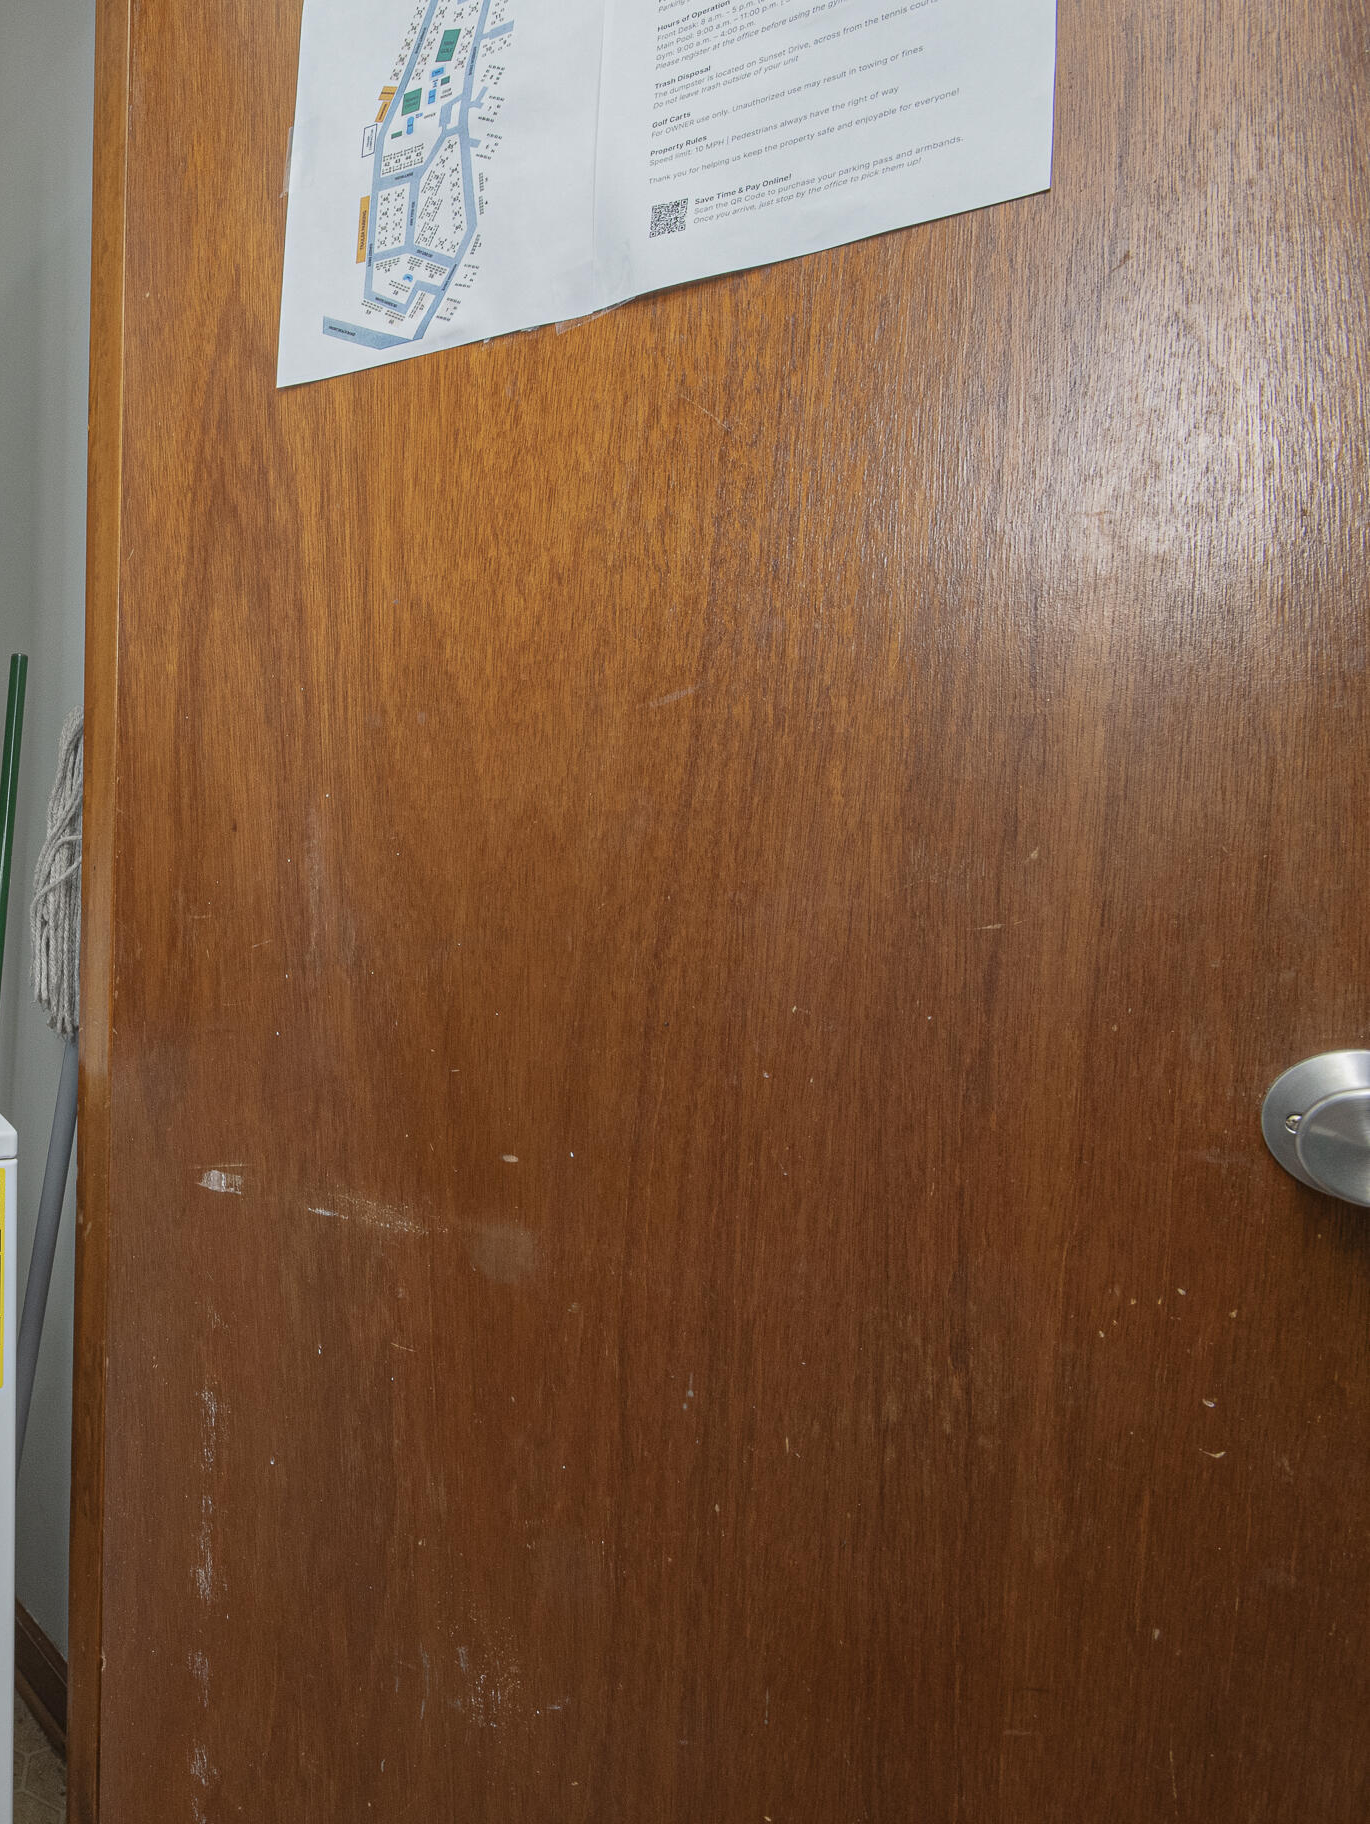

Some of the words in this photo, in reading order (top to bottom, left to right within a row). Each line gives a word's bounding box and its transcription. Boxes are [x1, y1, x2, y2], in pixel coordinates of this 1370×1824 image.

[657, 19, 680, 31] Hours
[681, 14, 689, 22] of
[691, 0, 730, 19] Operation
[651, 126, 665, 137] For
[664, 118, 694, 133] OWNER
[696, 113, 711, 123] use
[732, 89, 785, 112] Unauthorized
[787, 86, 802, 94] use
[803, 79, 821, 89] may
[822, 70, 846, 83] result
[848, 66, 857, 75] in
[858, 55, 888, 72] towing
[888, 53, 899, 62] or
[901, 45, 925, 57] fines
[654, 78, 676, 88] Trash
[677, 65, 710, 81] Disposal
[648, 153, 673, 166] Speed
[693, 142, 705, 152] 10
[705, 138, 724, 149] MPH
[731, 122, 778, 141] Pedestrians
[779, 112, 808, 127] always
[806, 107, 829, 119] have
[830, 102, 845, 111] the
[847, 95, 867, 106] right
[869, 90, 879, 100] of
[879, 86, 899, 96] way
[651, 117, 668, 127] Golf
[669, 112, 690, 122] Carts
[648, 174, 670, 184] Thank
[672, 170, 687, 179] you
[701, 157, 729, 170] helping
[743, 145, 763, 159] keep
[764, 143, 778, 152] the
[779, 129, 816, 149] property
[815, 126, 834, 136] safe
[836, 119, 854, 131] and
[852, 107, 898, 127] enjoyable
[899, 102, 912, 112] for
[914, 87, 959, 108] everyone!
[650, 142, 684, 156] Property
[685, 135, 707, 145] Rules
[693, 202, 714, 213] Scan
[713, 197, 730, 208] the
[729, 193, 744, 204] QR
[743, 187, 768, 200] Code
[767, 185, 777, 195] to
[775, 175, 815, 193] purchase
[814, 171, 836, 183] your
[837, 159, 871, 177] parking
[871, 155, 893, 168] pass
[895, 148, 912, 159] and
[694, 195, 714, 204] Save
[716, 190, 736, 198] Time
[745, 183, 761, 192] Pay
[762, 173, 791, 186] Online!
